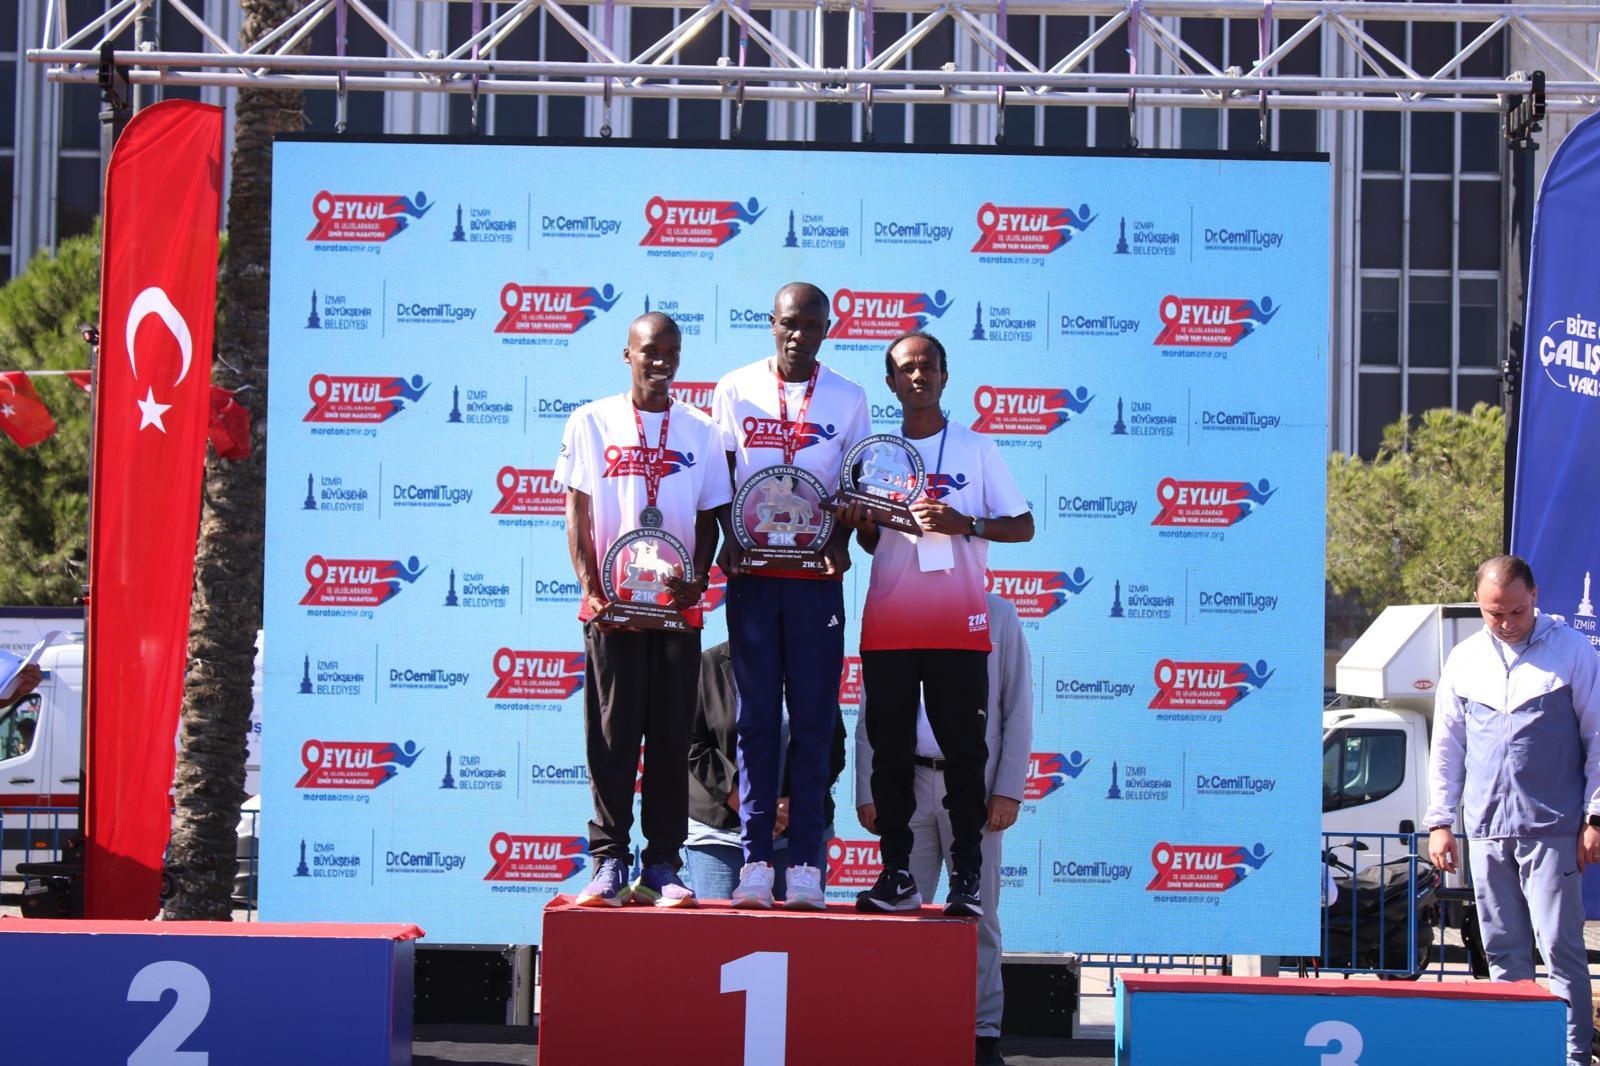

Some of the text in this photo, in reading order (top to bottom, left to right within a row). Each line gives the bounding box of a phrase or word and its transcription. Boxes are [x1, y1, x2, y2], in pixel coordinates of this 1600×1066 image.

[333, 201, 386, 220] EYLÜL
[470, 206, 491, 217] İZMİR
[665, 206, 718, 226] EYLÜL
[802, 212, 823, 223] İZMİR
[997, 213, 1050, 232] EYLÜL
[1133, 219, 1154, 230] İZMİR
[325, 293, 346, 304] İZMİR
[520, 293, 573, 312] EYLÜL
[853, 298, 906, 318] EYLÜL
[990, 305, 1010, 316] İZMİR
[1179, 306, 1232, 325] EYLÜL
[1566, 314, 1596, 339] BİZE
[834, 342, 886, 352] maratonizmir
[329, 383, 382, 402] EYLÜL
[466, 388, 487, 399] İZMİR
[1568, 374, 1600, 396] YAKI
[994, 394, 1047, 414] EYLÜL
[1131, 400, 1152, 411] İZMİR
[321, 475, 342, 486] İZMİR
[735, 470, 768, 515] INTERNATIONAL
[773, 466, 797, 474] EYLÜL
[796, 469, 816, 484] İZMİR
[813, 482, 827, 499] HALF
[1177, 487, 1229, 506] EYLÜL
[770, 534, 794, 545] 21K
[604, 531, 637, 570] INTERNATIONAL
[677, 546, 688, 563] HALF
[325, 566, 378, 585] EYLÜL
[463, 571, 484, 582] İZMİR
[1128, 582, 1149, 593] İZMİR
[968, 613, 987, 627] 21K
[1574, 616, 1596, 630] İZMİR
[317, 658, 338, 669] İZMİR
[513, 658, 566, 677] EYLÜL
[1174, 669, 1227, 688] EYLÜL
[322, 749, 374, 768] EYLÜL
[459, 754, 480, 765] İZMİR
[1125, 764, 1146, 775] İZMİR
[314, 842, 334, 853] İZMİR
[509, 842, 562, 861] EYLÜL
[1172, 851, 1224, 870] EYLÜL
[127, 960, 210, 1066] 2
[720, 951, 788, 1066] 1
